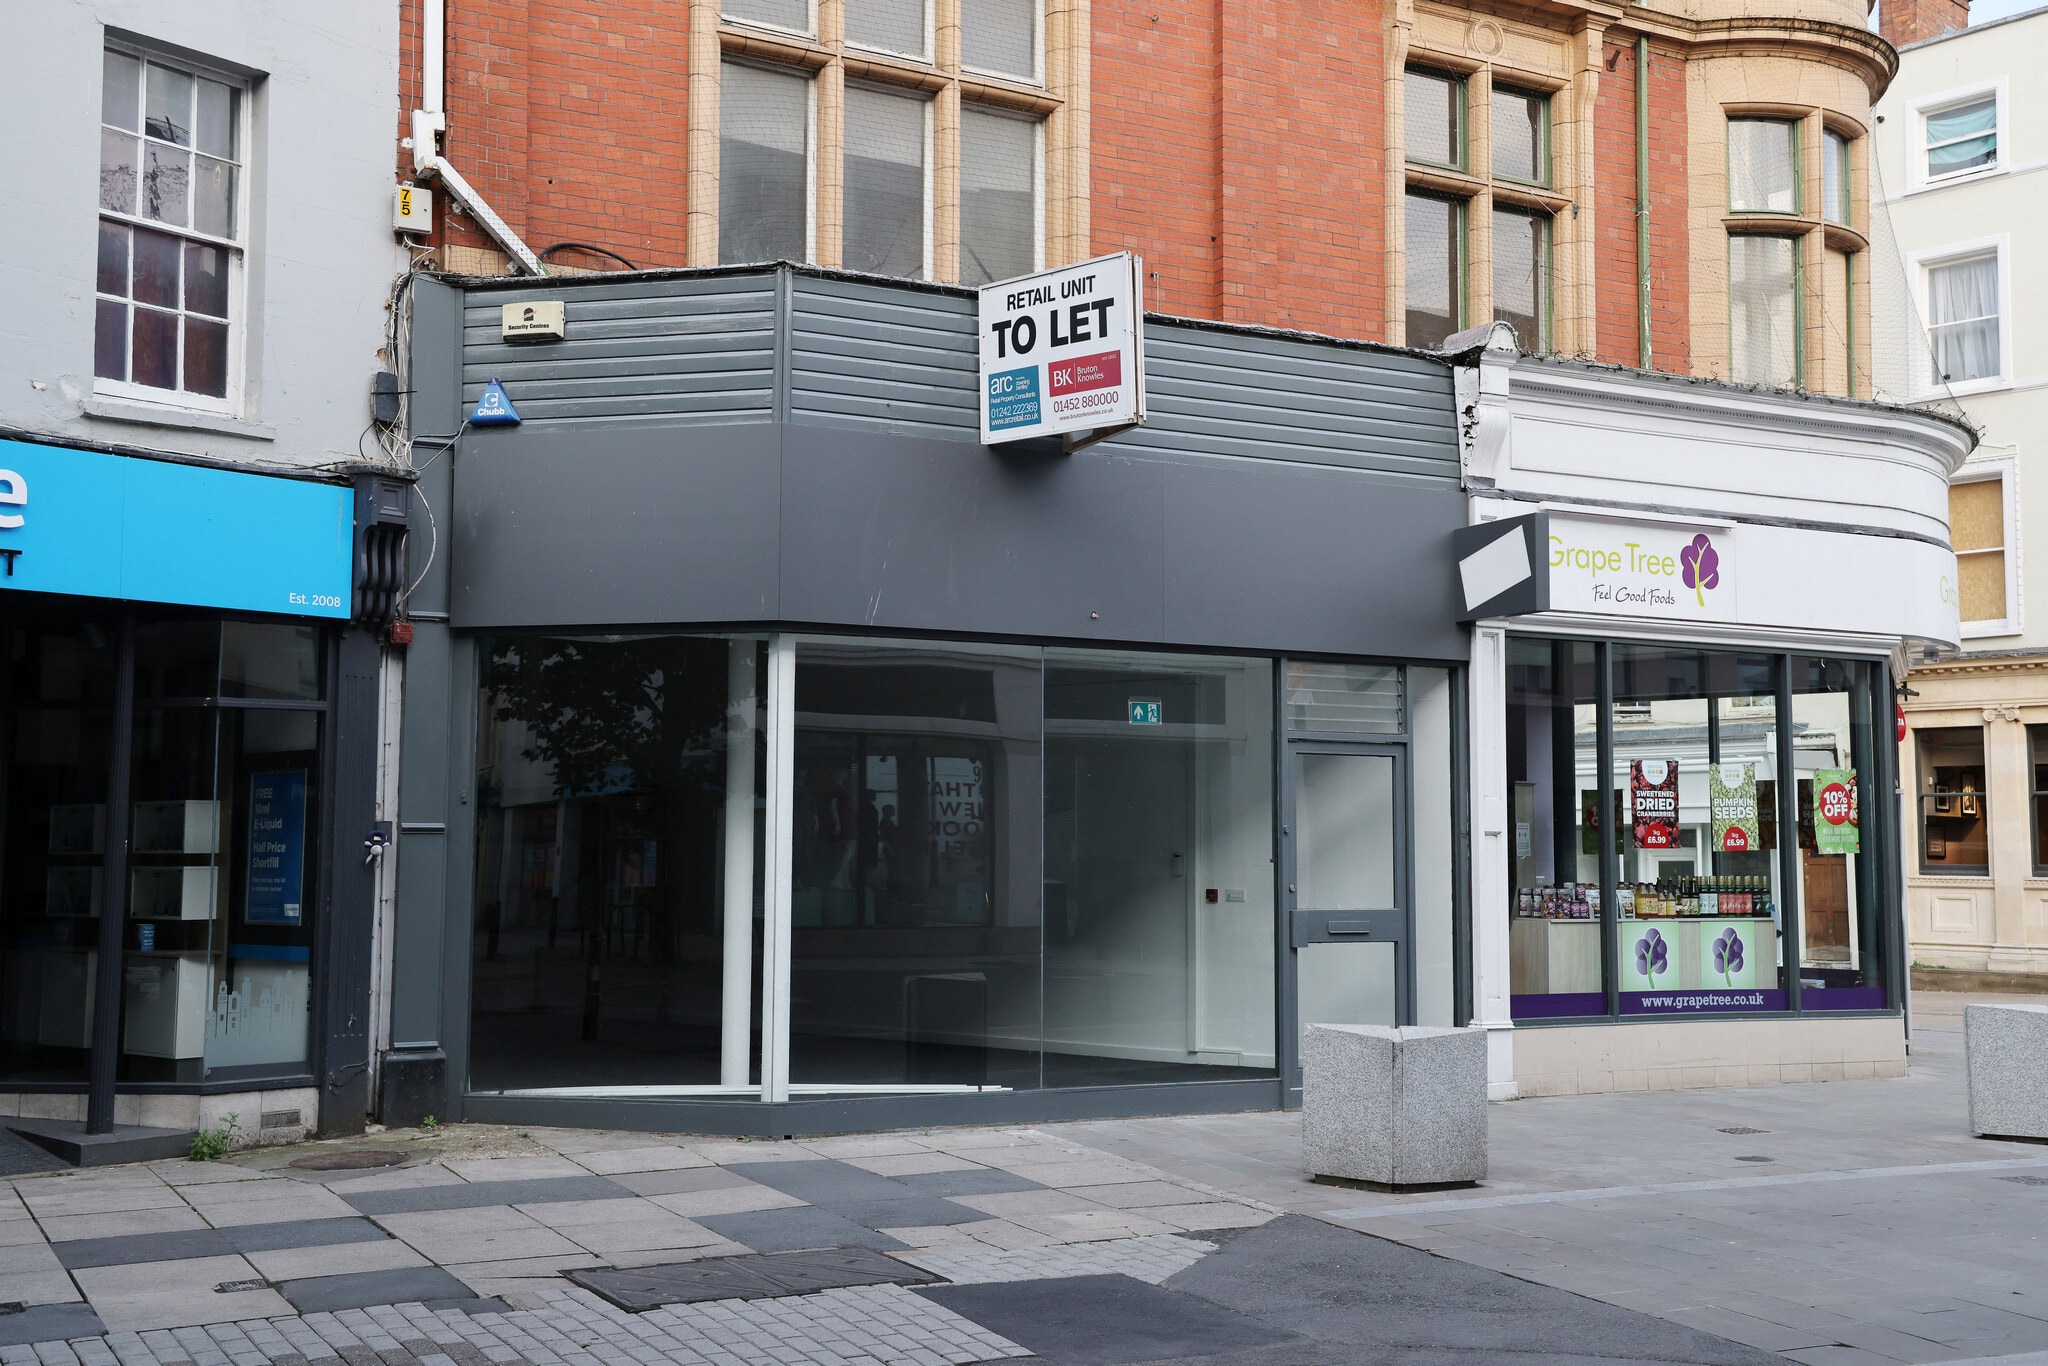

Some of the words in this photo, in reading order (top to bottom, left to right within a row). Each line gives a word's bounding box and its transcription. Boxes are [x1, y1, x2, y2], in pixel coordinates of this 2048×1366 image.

[1007, 286, 1056, 311] RETAIL
[1061, 275, 1096, 299] UNIT
[992, 315, 1037, 359] TO
[1050, 297, 1115, 348] LET
[1077, 365, 1098, 375] Bruton
[1053, 368, 1073, 387] BK
[1077, 372, 1104, 383] Knowles
[991, 376, 1013, 395] arc
[991, 396, 1001, 404] Retail
[1015, 391, 1036, 400] Consultants
[1053, 397, 1080, 413] 01452
[1082, 391, 1119, 409] 880000
[477, 407, 505, 416] Chubb
[991, 406, 1012, 418] 01242
[1012, 402, 1038, 415] 222369
[1059, 408, 1114, 421] www.brutonknowles.co.uk
[991, 412, 1039, 426] www.arcretail.co.uk
[1549, 535, 1621, 578] Grape
[1625, 543, 1675, 576] Tree
[289, 592, 309, 605] Est.
[312, 594, 341, 608] 2008
[1592, 584, 1612, 603] Feel
[1615, 586, 1646, 604] Good
[1648, 588, 1676, 606] Foods
[255, 788, 273, 799] FREE
[1823, 791, 1848, 804] 10%
[1637, 798, 1675, 810] DRIED
[1714, 798, 1753, 807] PUMPKIN
[1715, 807, 1754, 819] SEEDS
[1824, 804, 1848, 817] OFF
[253, 818, 282, 831] E-Liquid
[1647, 836, 1666, 844] £6.99
[253, 841, 267, 853] Half
[267, 841, 287, 853] Price
[252, 857, 280, 869] Shortfill
[1641, 992, 1764, 1009] www.grapetree.co.uk
